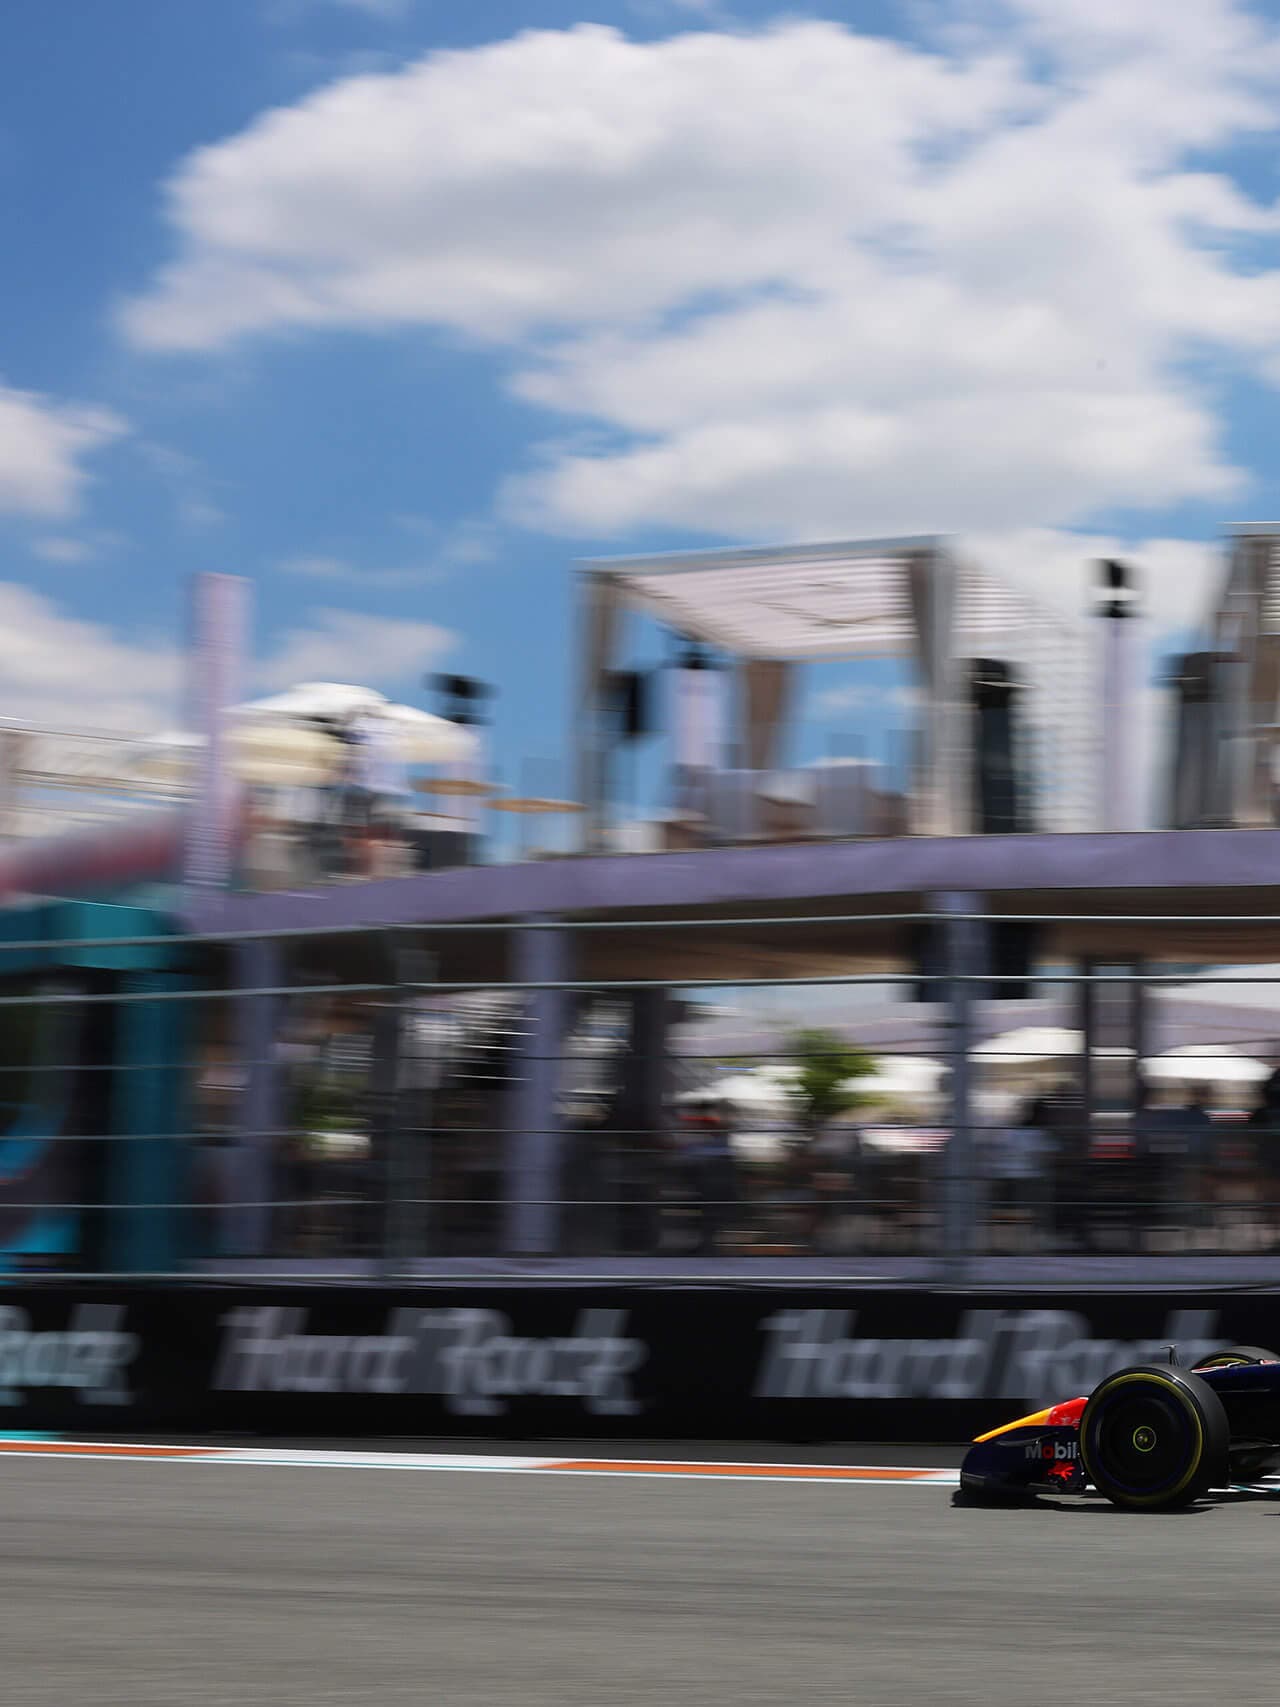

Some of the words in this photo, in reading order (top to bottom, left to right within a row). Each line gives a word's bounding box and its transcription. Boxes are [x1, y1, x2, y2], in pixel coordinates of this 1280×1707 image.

[0, 1304, 142, 1406] ock
[208, 1306, 428, 1393] Hard
[412, 1307, 648, 1415] Rock
[1025, 1441, 1077, 1459] Mobil
